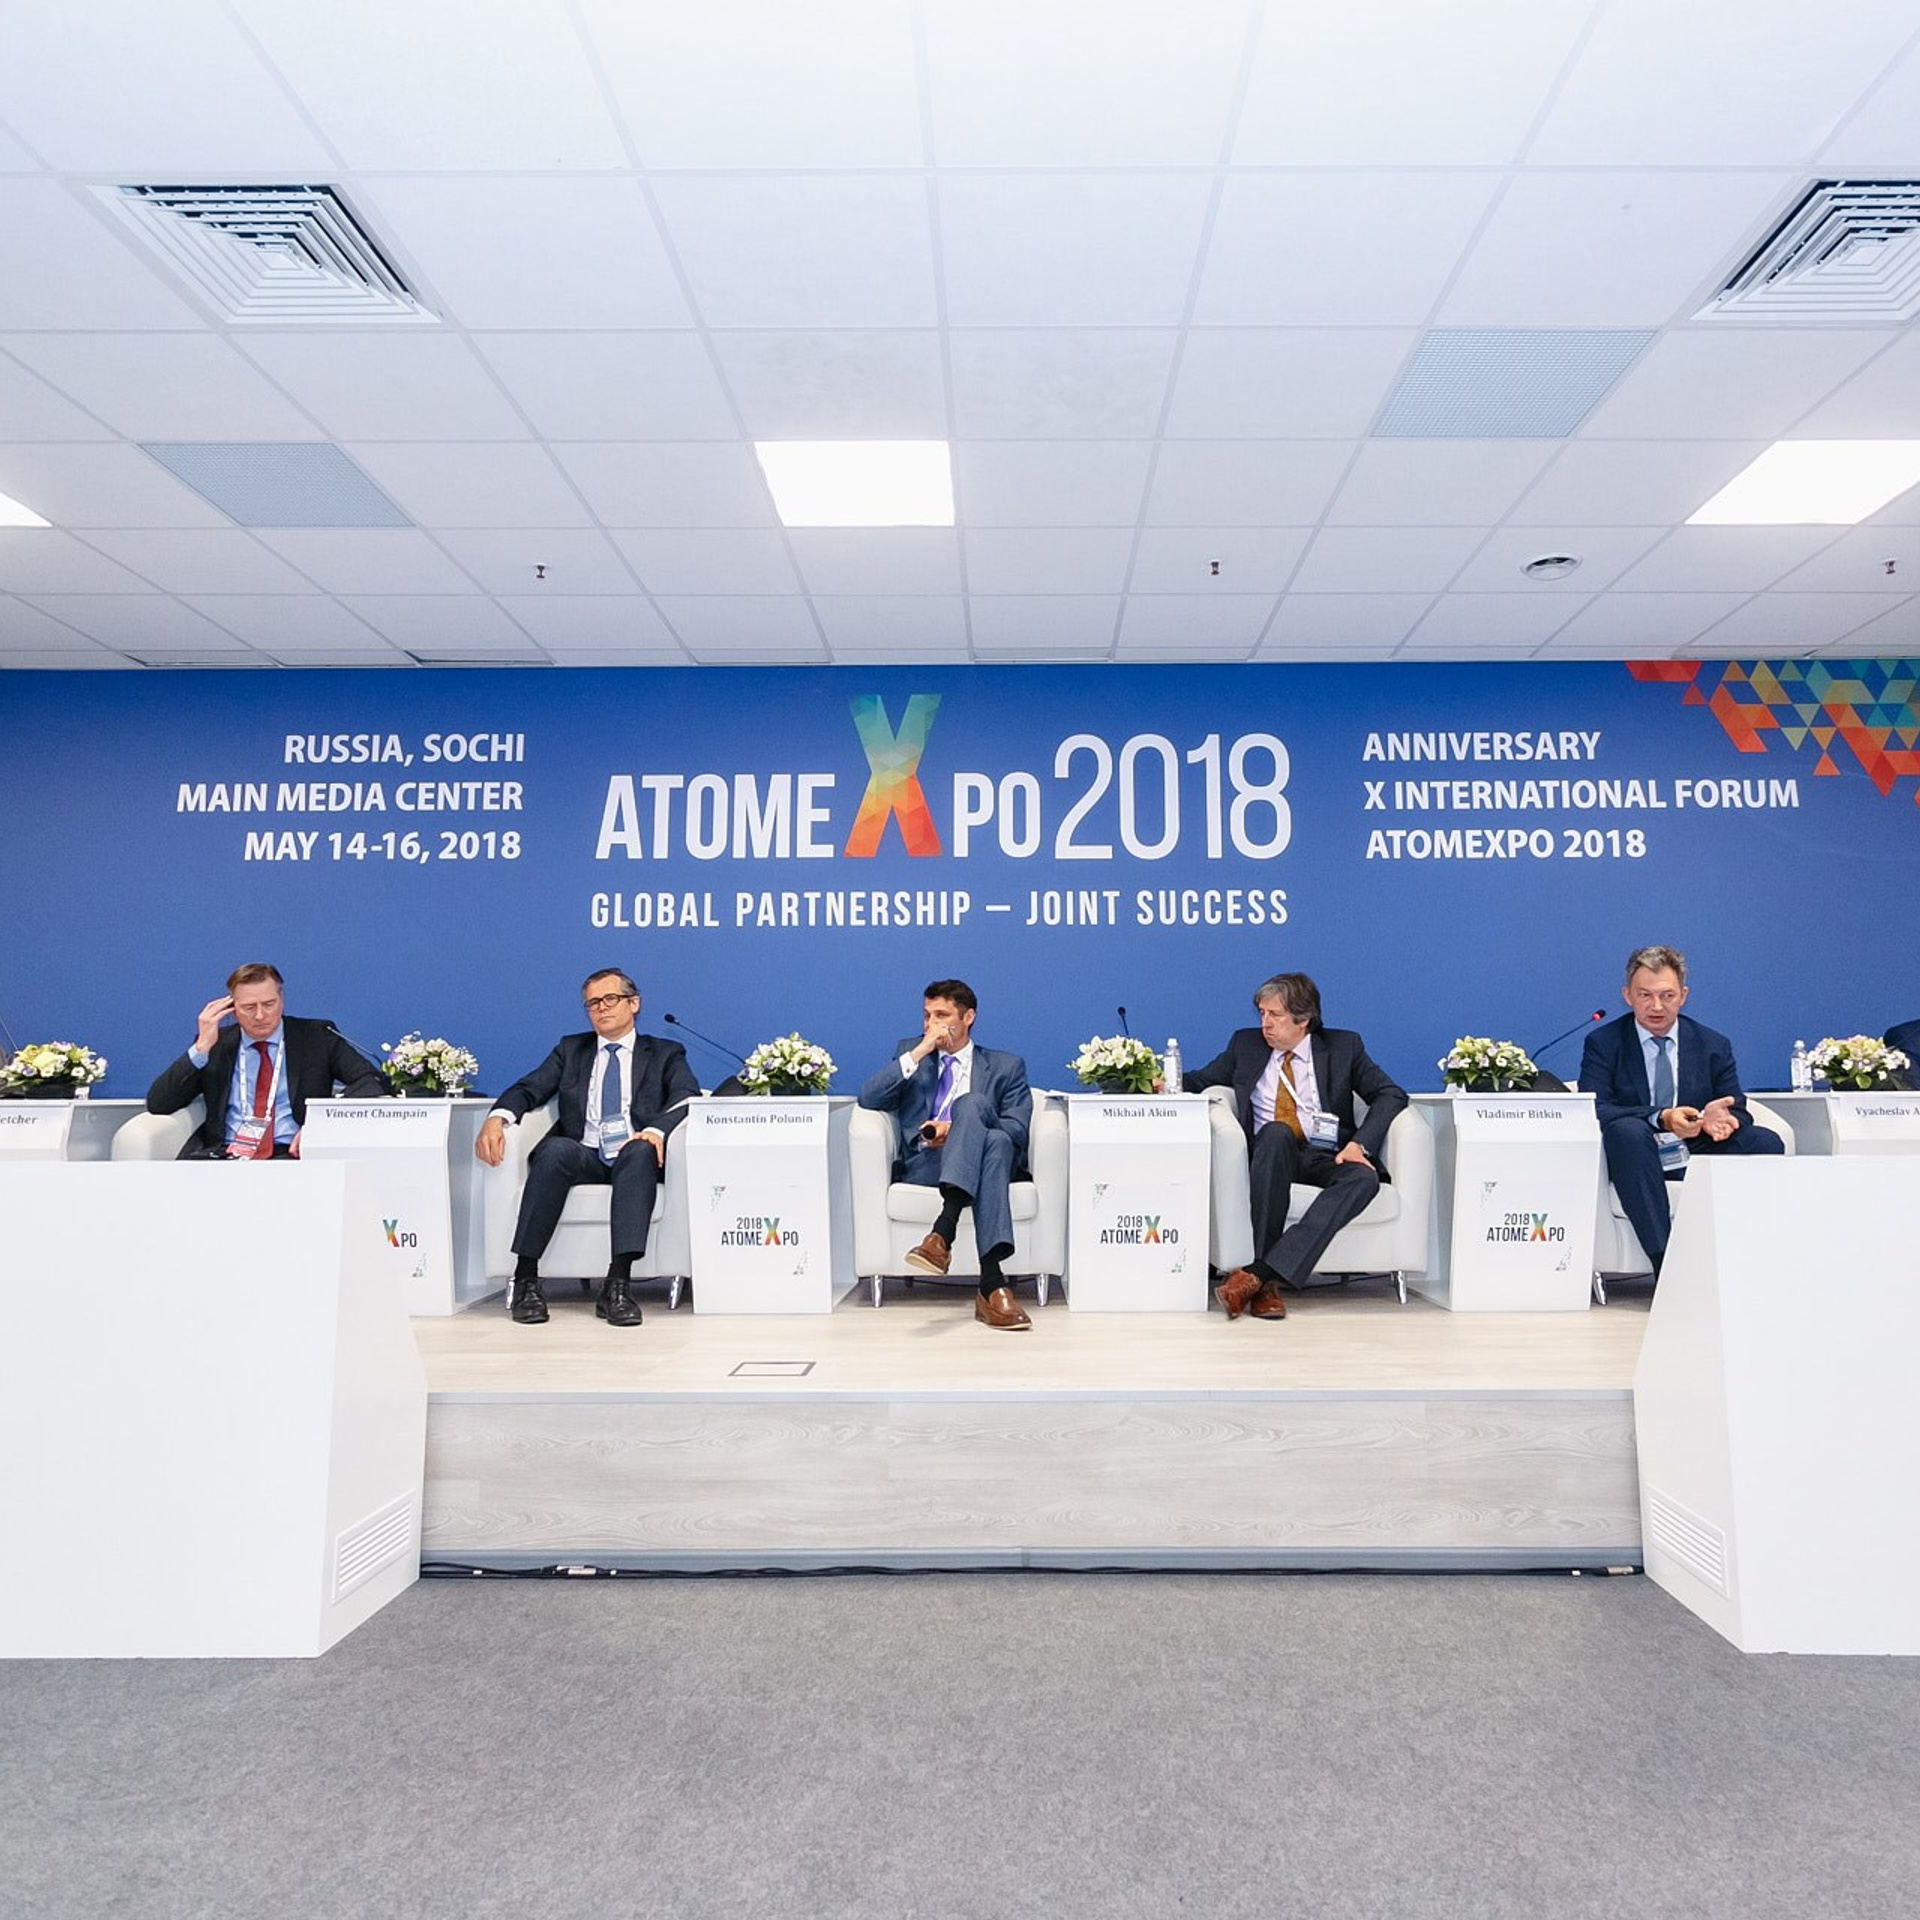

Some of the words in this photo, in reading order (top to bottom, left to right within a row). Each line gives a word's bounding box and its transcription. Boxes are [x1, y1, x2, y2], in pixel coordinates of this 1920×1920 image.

[284, 734, 414, 767] RUSSIA,
[422, 733, 525, 763] SOCHI
[1362, 731, 1601, 761] ANNIVERSARY
[594, 694, 1042, 861] ATOMEXPO
[1054, 732, 1292, 861] 2018
[176, 783, 268, 813] MAIN
[276, 782, 387, 812] MEDIA
[395, 781, 523, 811] CENTER
[1363, 781, 1386, 810] X
[1394, 779, 1668, 810] INTERNATIONAL
[1674, 779, 1800, 809] FORUM
[244, 831, 320, 861] MAY
[328, 831, 430, 864] 14-16,
[438, 830, 521, 860] 2018
[1366, 828, 1555, 860] ATOMEXPO
[1562, 829, 1647, 858] 2018
[591, 892, 720, 928] GLOBAL
[736, 890, 971, 927] PARTNERSHIP
[1025, 890, 1121, 926] JOINT
[1136, 889, 1288, 926] SUCCESS
[325, 1108, 369, 1118] Vincent
[370, 1108, 428, 1120] Champain
[706, 1114, 766, 1125] Konstantin
[769, 1113, 813, 1124] Polunin
[1102, 1108, 1145, 1117] Mikhail
[1147, 1108, 1178, 1117] Akim
[1476, 1109, 1526, 1119] Vladimir
[1528, 1109, 1563, 1119] Bitkin
[1855, 1107, 1910, 1118] Vyacheslav
[736, 1217, 763, 1230] 2018
[1117, 1215, 1143, 1228] 2018
[1504, 1213, 1530, 1226] 2018
